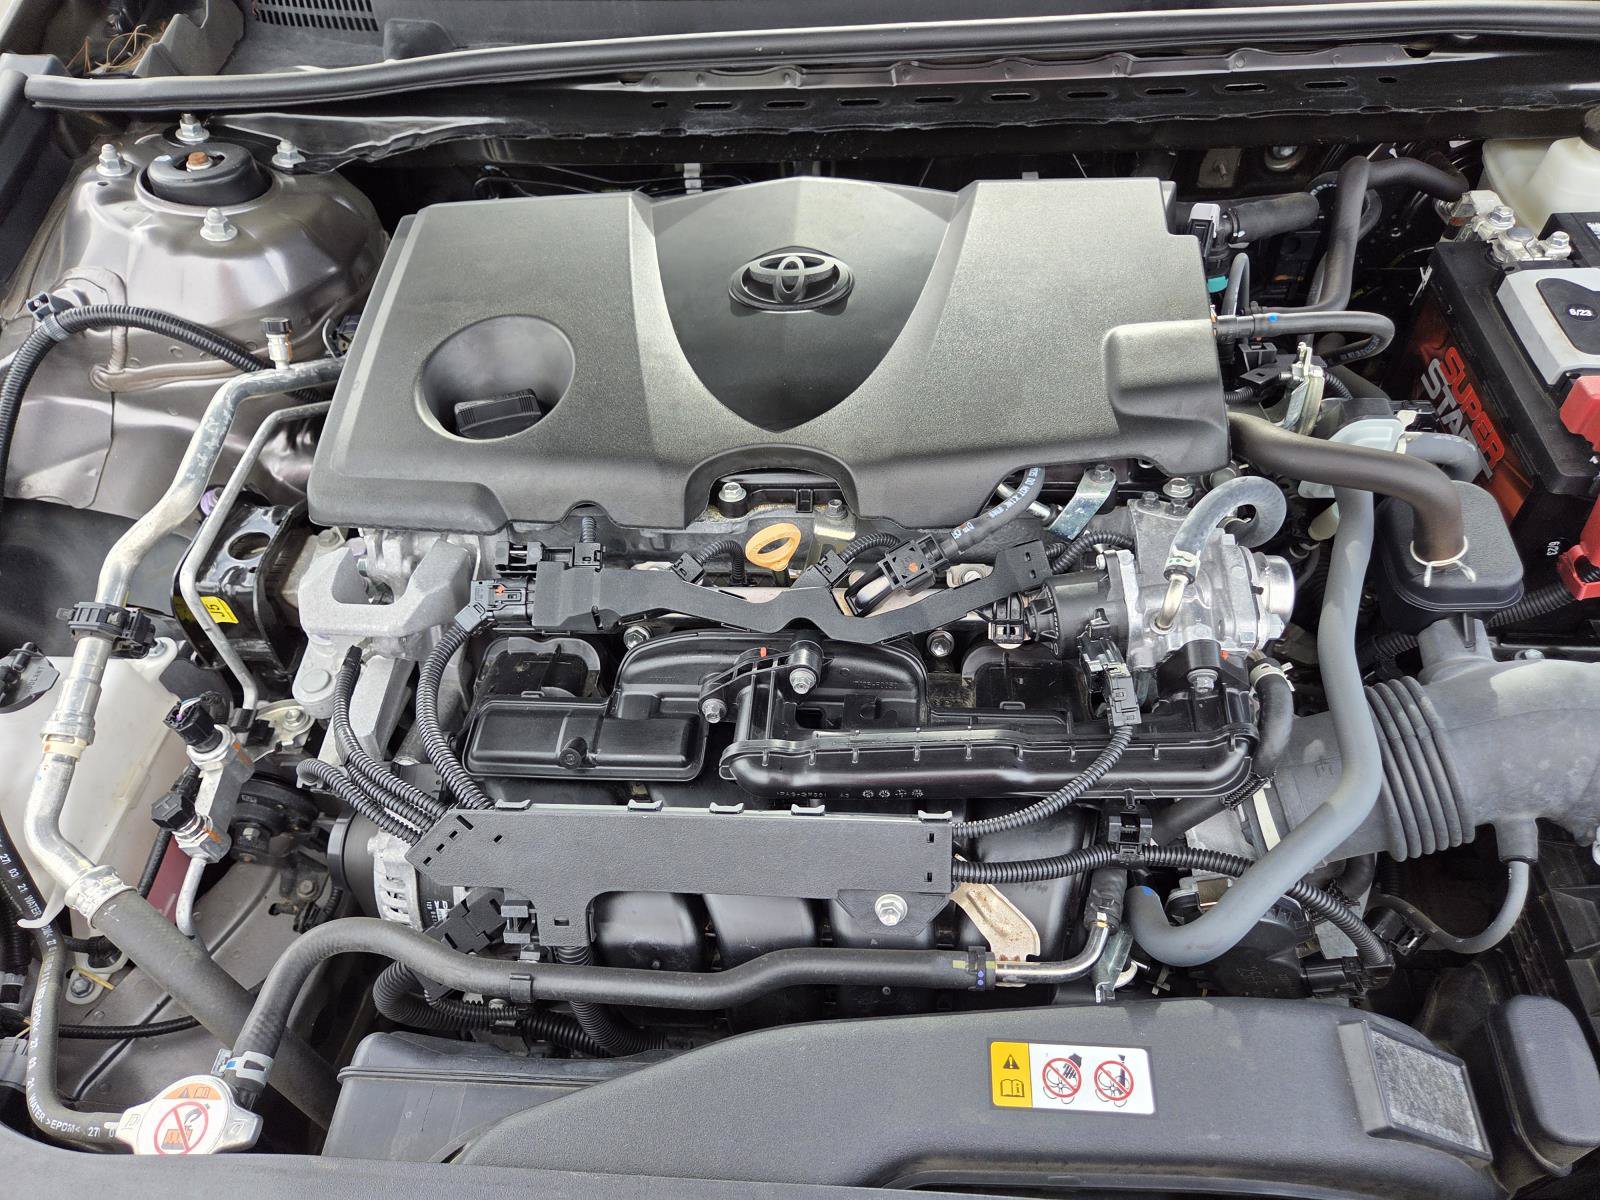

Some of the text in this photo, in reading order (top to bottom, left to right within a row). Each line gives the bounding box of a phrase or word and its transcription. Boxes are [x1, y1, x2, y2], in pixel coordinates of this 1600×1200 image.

[1440, 346, 1505, 469] SUPER
[24, 893, 42, 918] WATER
[29, 1093, 46, 1125] WATER
